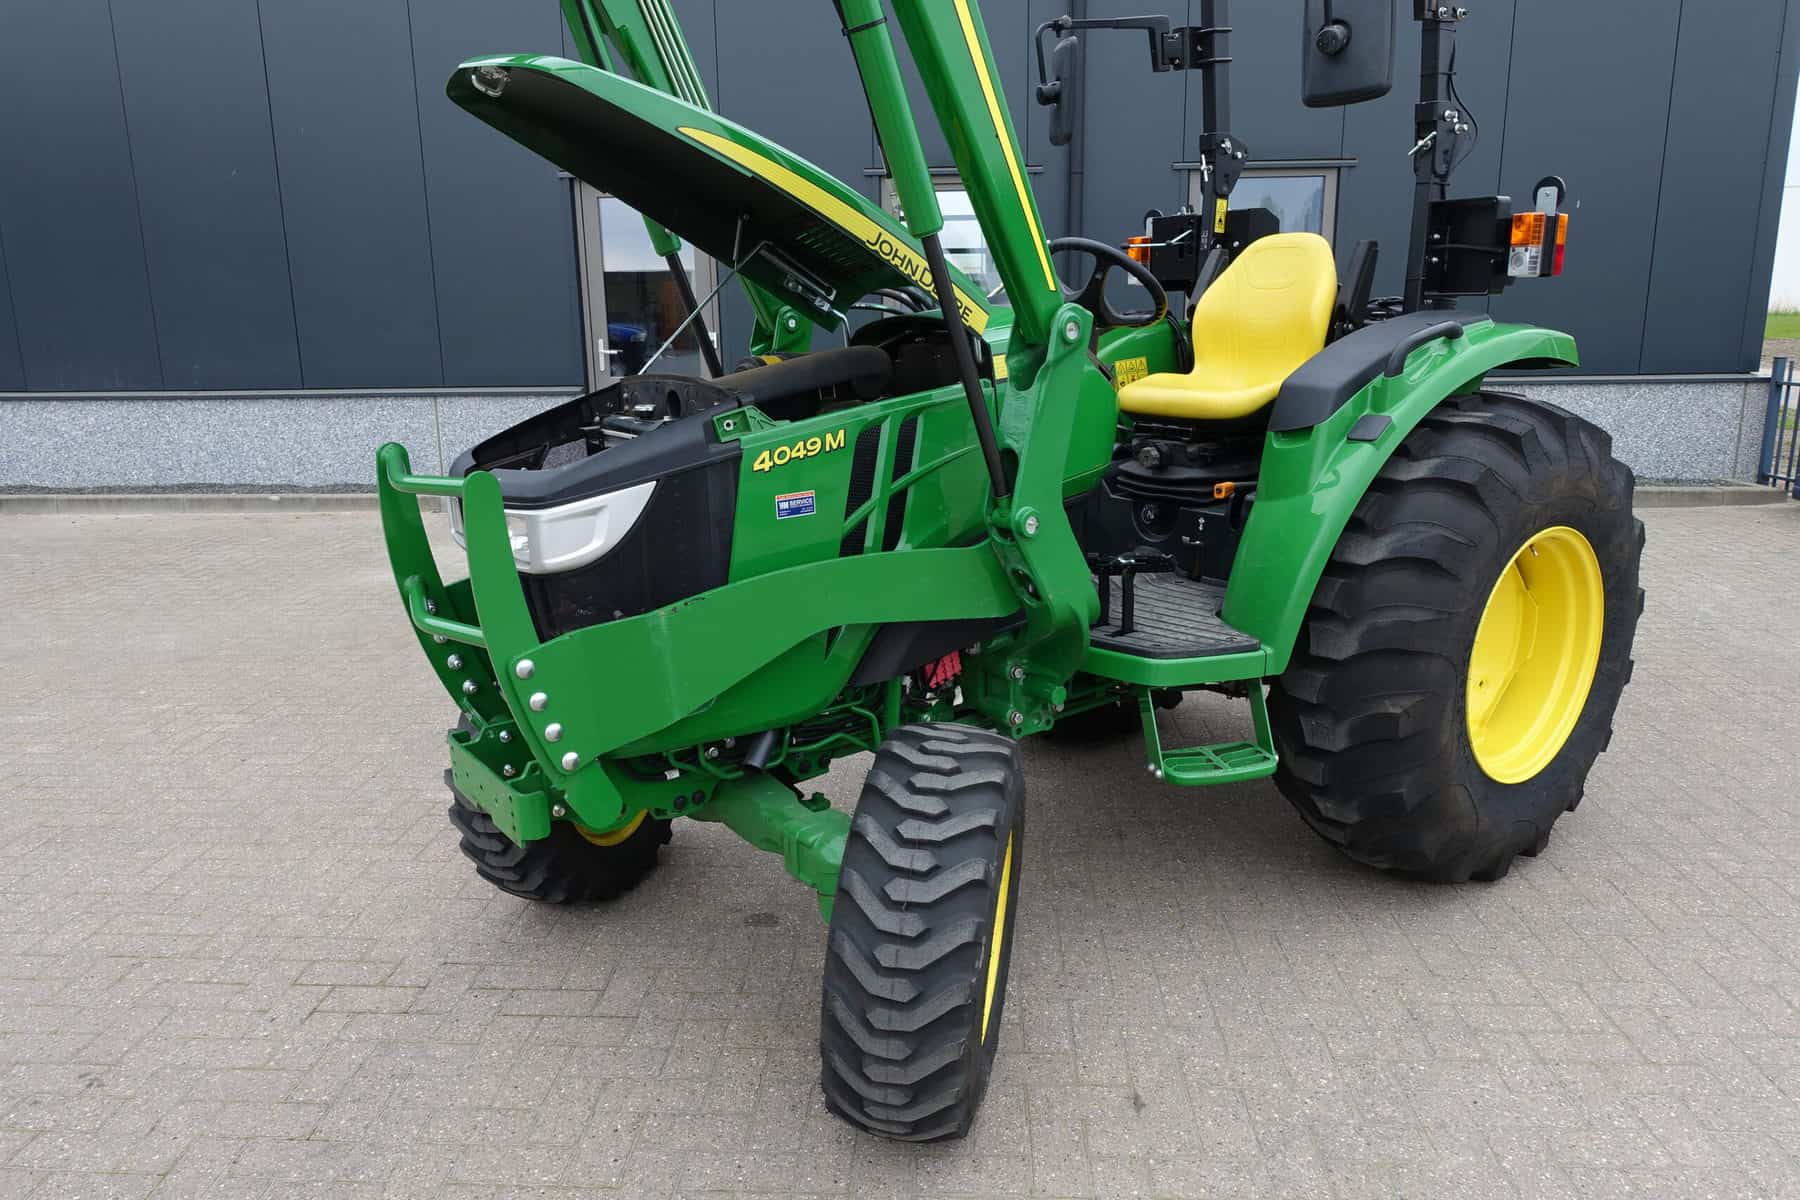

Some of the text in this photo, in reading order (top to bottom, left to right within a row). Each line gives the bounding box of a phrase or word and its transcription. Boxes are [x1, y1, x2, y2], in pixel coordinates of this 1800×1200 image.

[866, 231, 919, 278] JOHN
[752, 429, 846, 472] 4049 M
